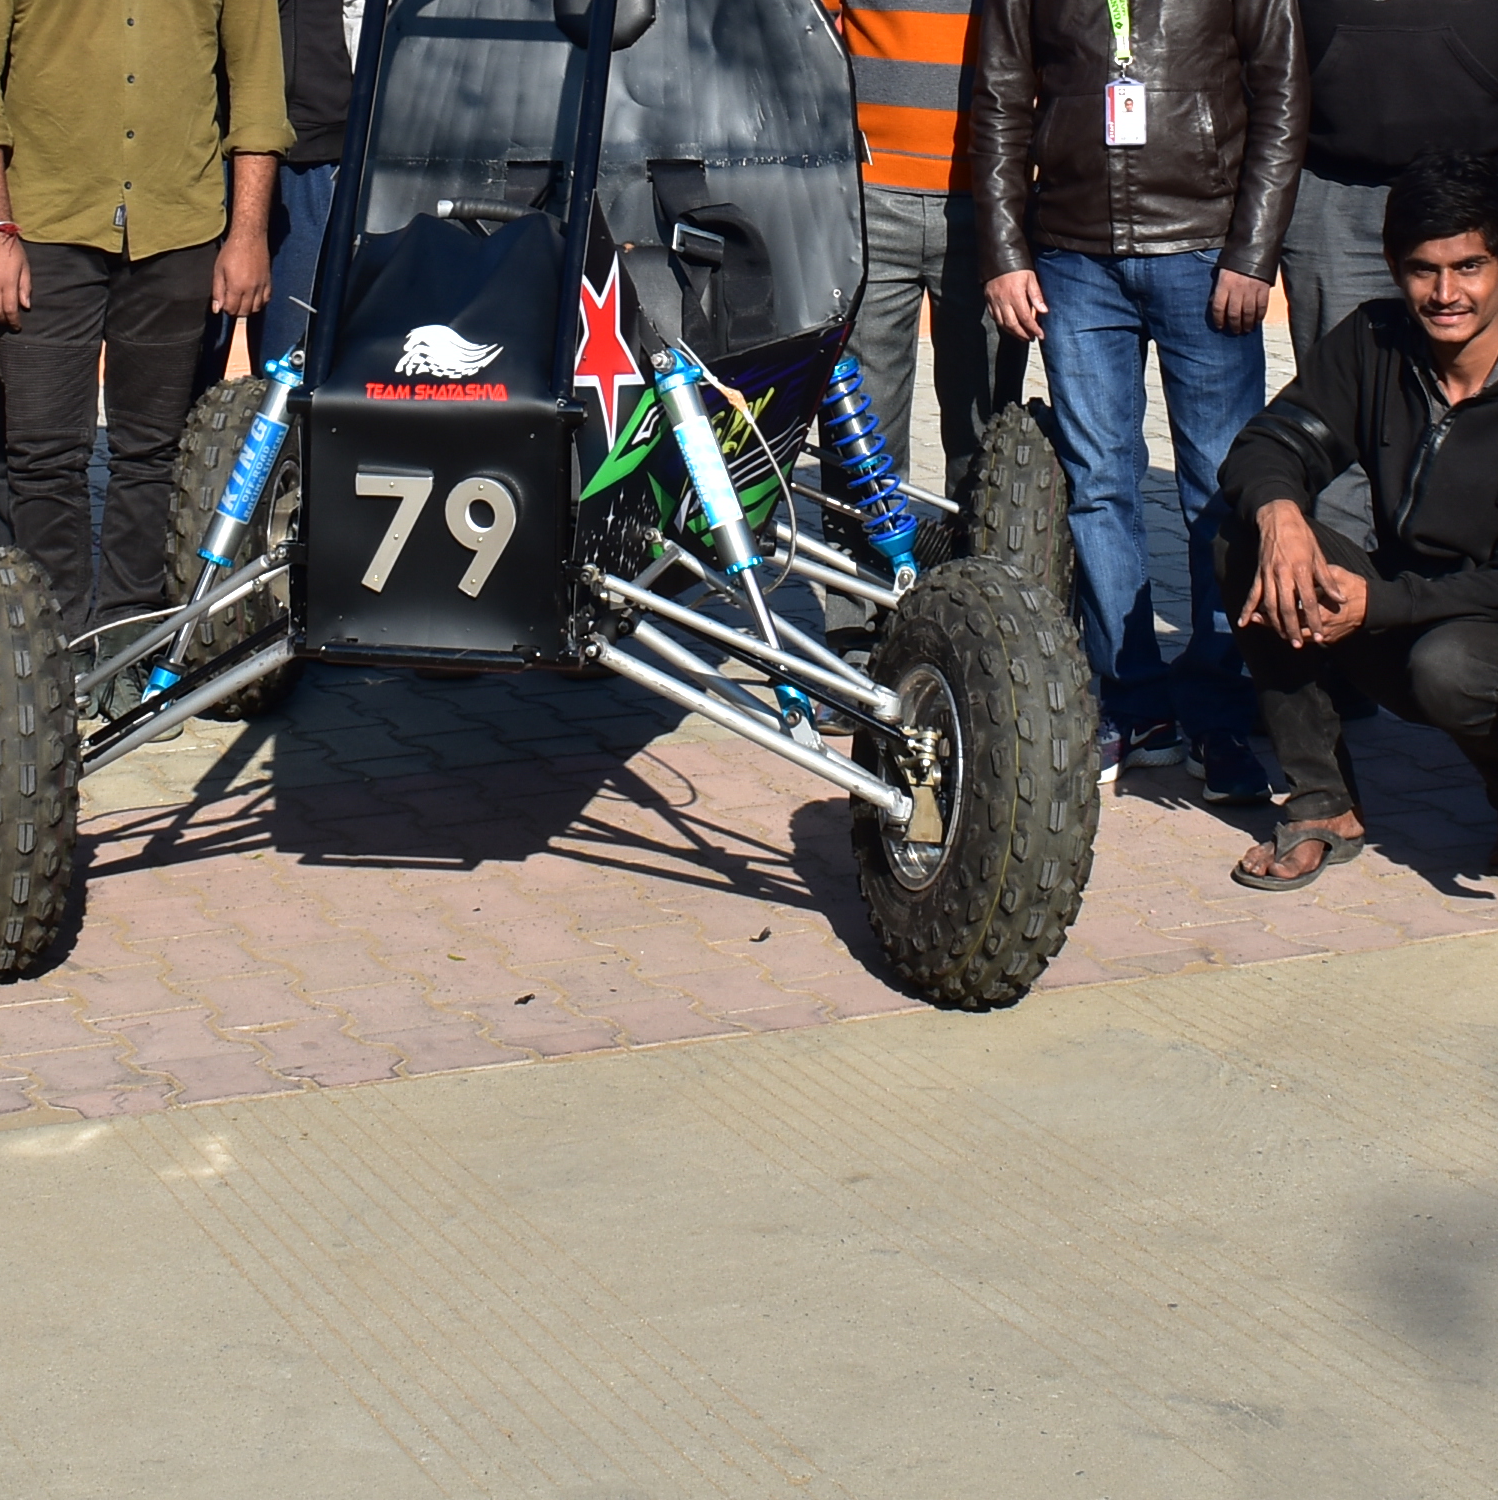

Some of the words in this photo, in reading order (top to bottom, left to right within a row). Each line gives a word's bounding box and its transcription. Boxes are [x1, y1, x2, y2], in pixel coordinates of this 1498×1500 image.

[365, 382, 411, 400] TEAM
[414, 383, 508, 401] SHATASHVA
[222, 417, 268, 512] KING
[241, 445, 271, 503] OFF-ROAD
[243, 475, 265, 518] RACING
[355, 472, 517, 598] 79
